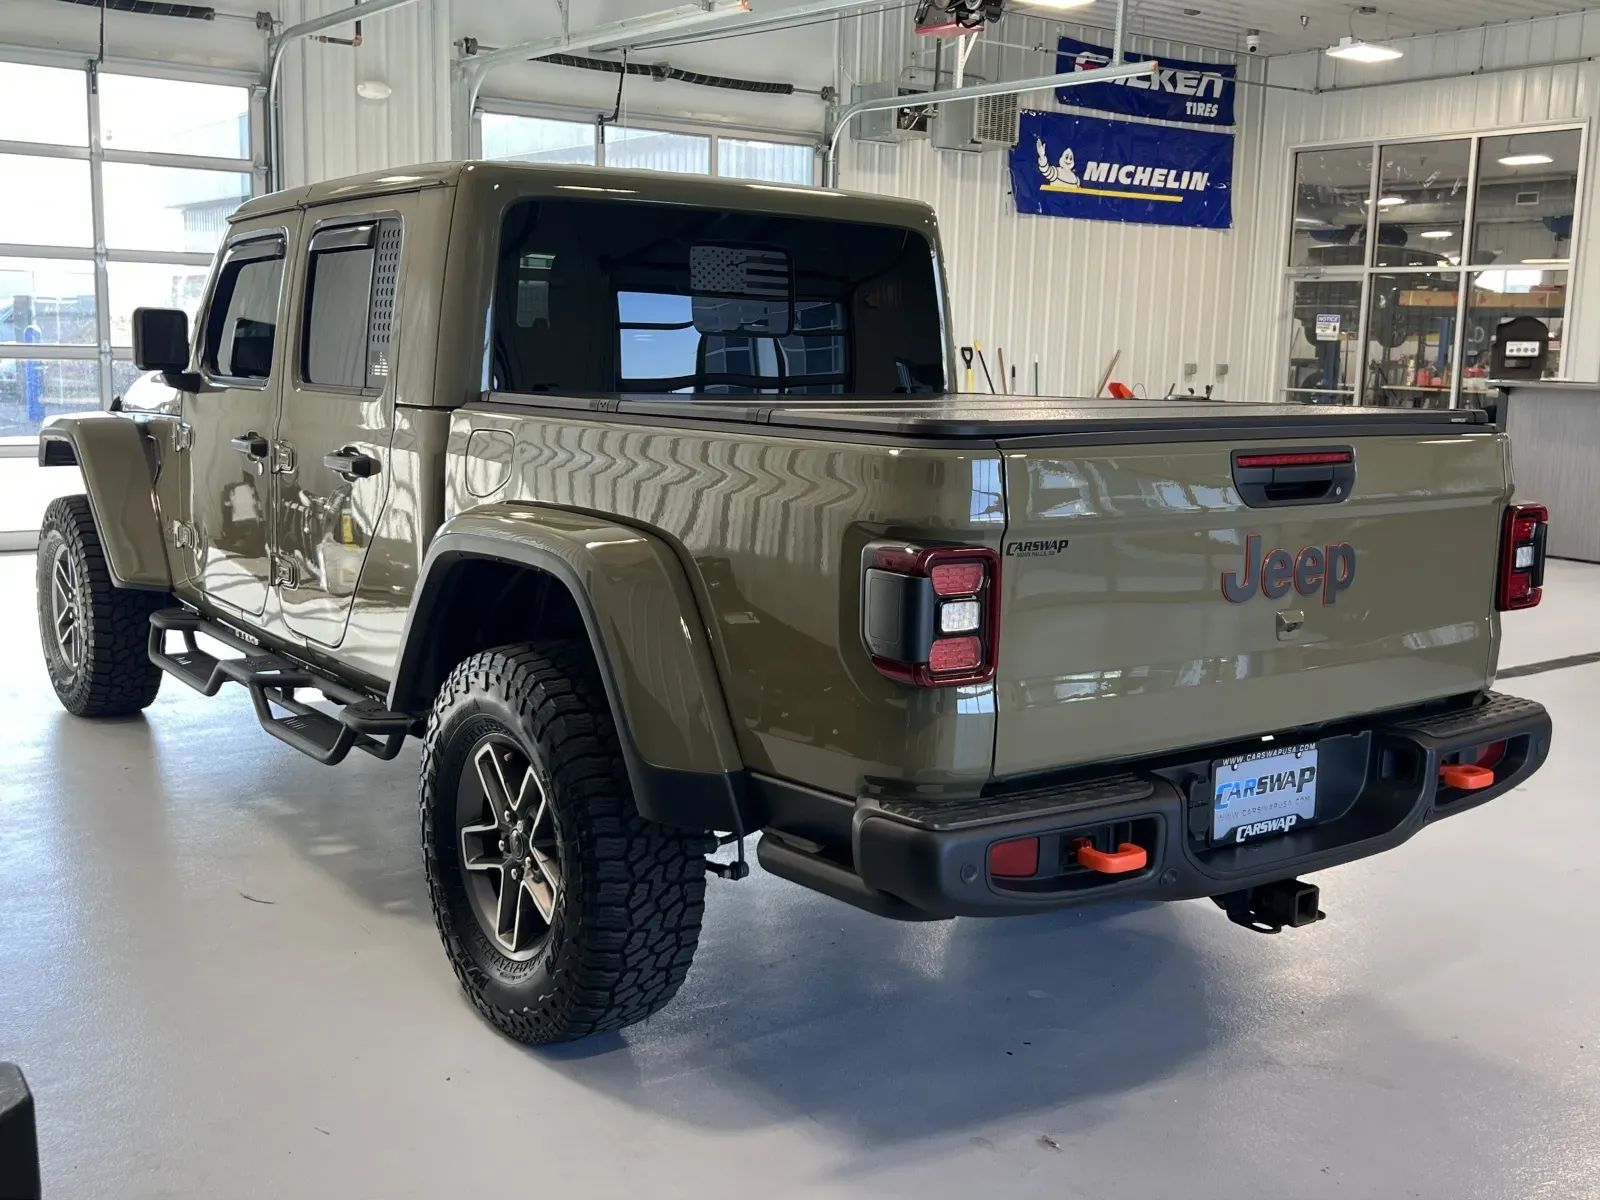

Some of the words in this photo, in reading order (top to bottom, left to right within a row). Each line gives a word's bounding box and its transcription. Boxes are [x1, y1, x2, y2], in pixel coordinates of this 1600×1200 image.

[1186, 102, 1218, 117] TIRES
[1083, 161, 1209, 191] MICHELIN
[1006, 540, 1068, 556] CARSWAP
[1221, 534, 1355, 606] Jeep
[1222, 743, 1316, 766] WWW.CARSWAPUSA.COM
[1215, 766, 1316, 811] CARSWAP
[1236, 815, 1297, 843] CARSWAP
